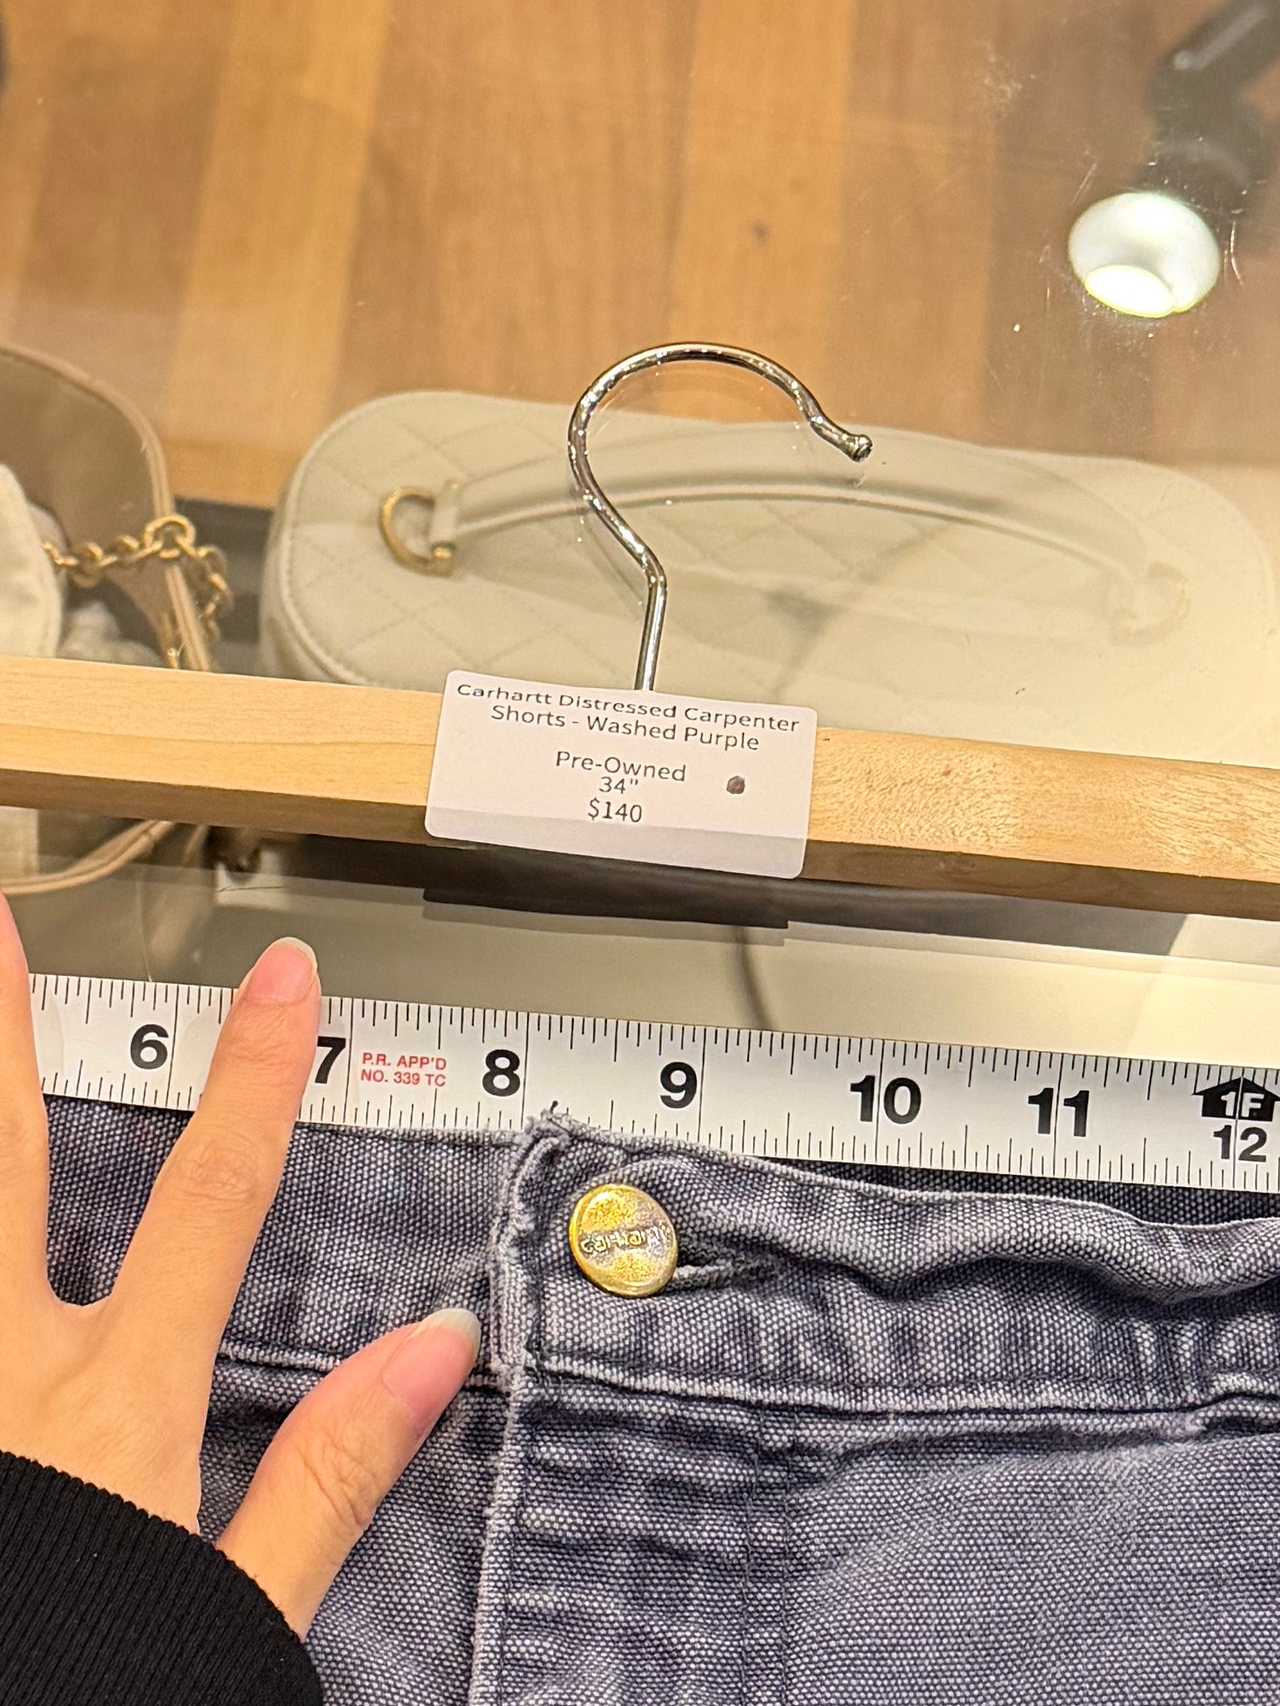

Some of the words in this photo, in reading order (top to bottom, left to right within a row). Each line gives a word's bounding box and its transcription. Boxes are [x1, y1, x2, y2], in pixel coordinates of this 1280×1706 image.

[457, 683, 553, 705] Carhartt
[559, 694, 677, 718] Distressed
[684, 707, 800, 733] Carpenter
[491, 705, 566, 728] Shorts
[586, 715, 677, 741] Washed
[684, 727, 760, 752] Purple
[556, 751, 687, 783] Pre-Owned
[599, 777, 640, 795] 34"
[587, 797, 644, 823] $140
[129, 1023, 169, 1070] 6
[314, 1036, 348, 1085] 7
[362, 1052, 392, 1066] P.R.
[397, 1054, 448, 1071] APP'D
[360, 1069, 388, 1084] NO.
[393, 1071, 422, 1086] 339
[424, 1073, 447, 1088] TC
[481, 1048, 521, 1097] 8
[659, 1061, 699, 1109] 9
[849, 1073, 923, 1125] 10
[1026, 1086, 1090, 1138] 11
[1212, 1124, 1268, 1164] 12
